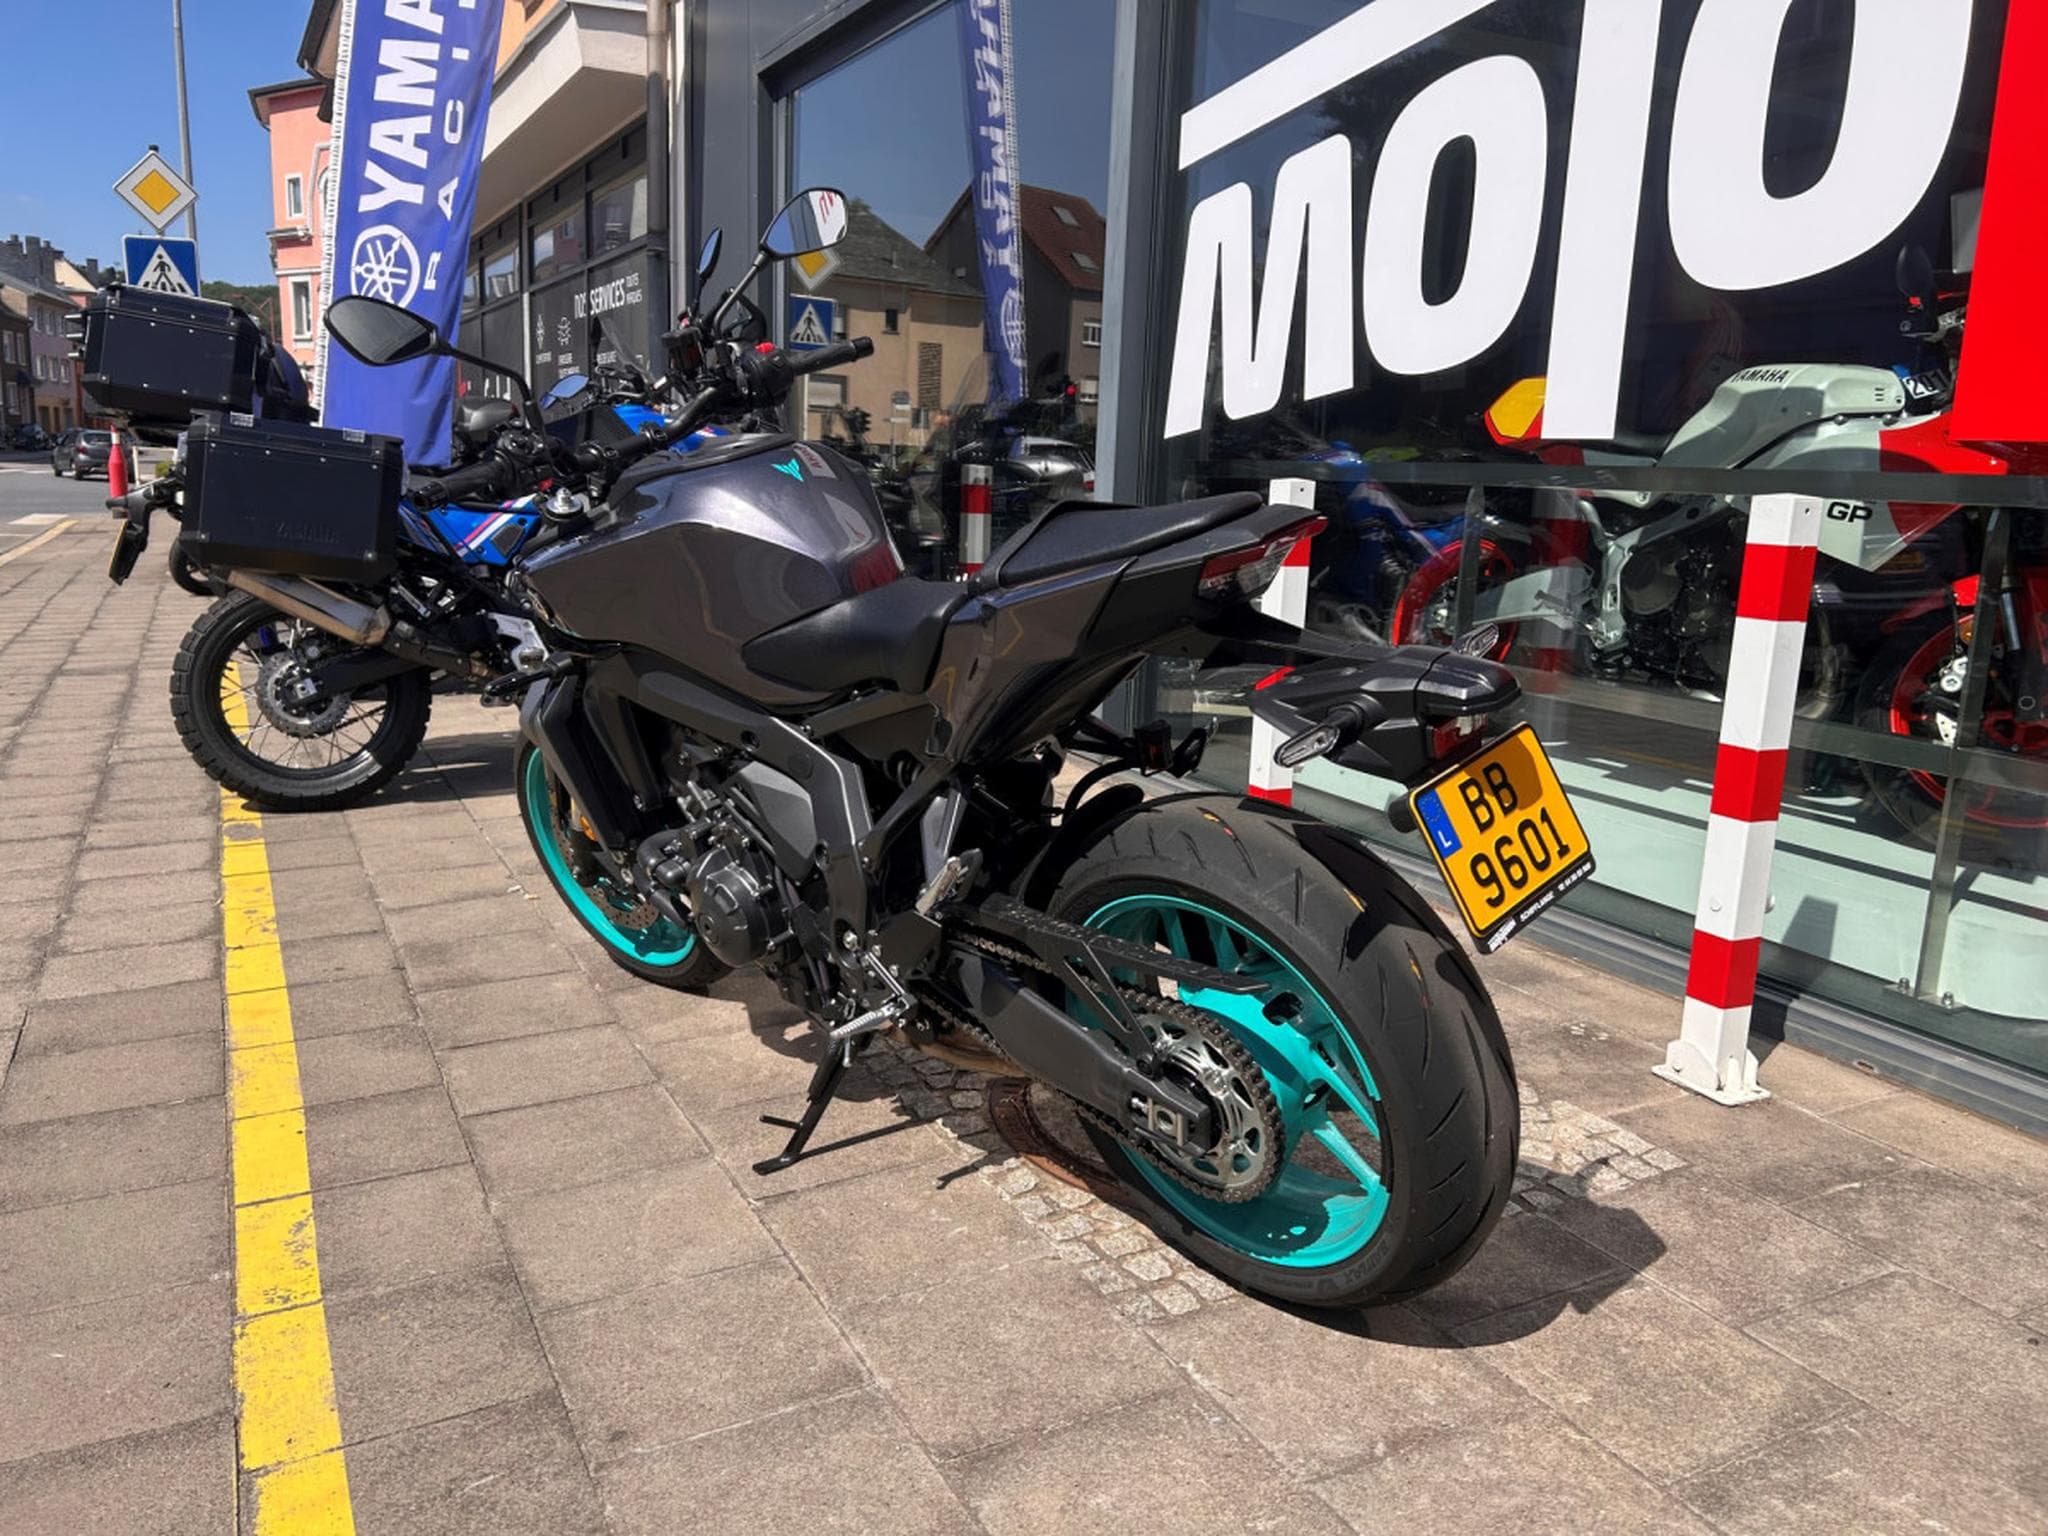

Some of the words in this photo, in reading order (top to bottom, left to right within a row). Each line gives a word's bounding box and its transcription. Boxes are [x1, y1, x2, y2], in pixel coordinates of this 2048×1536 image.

[590, 278, 625, 316] SERVICES
[1827, 501, 1873, 523] GP
[1459, 762, 1519, 834] BB
[1438, 830, 1453, 848] L
[1470, 807, 1571, 908] 9601
